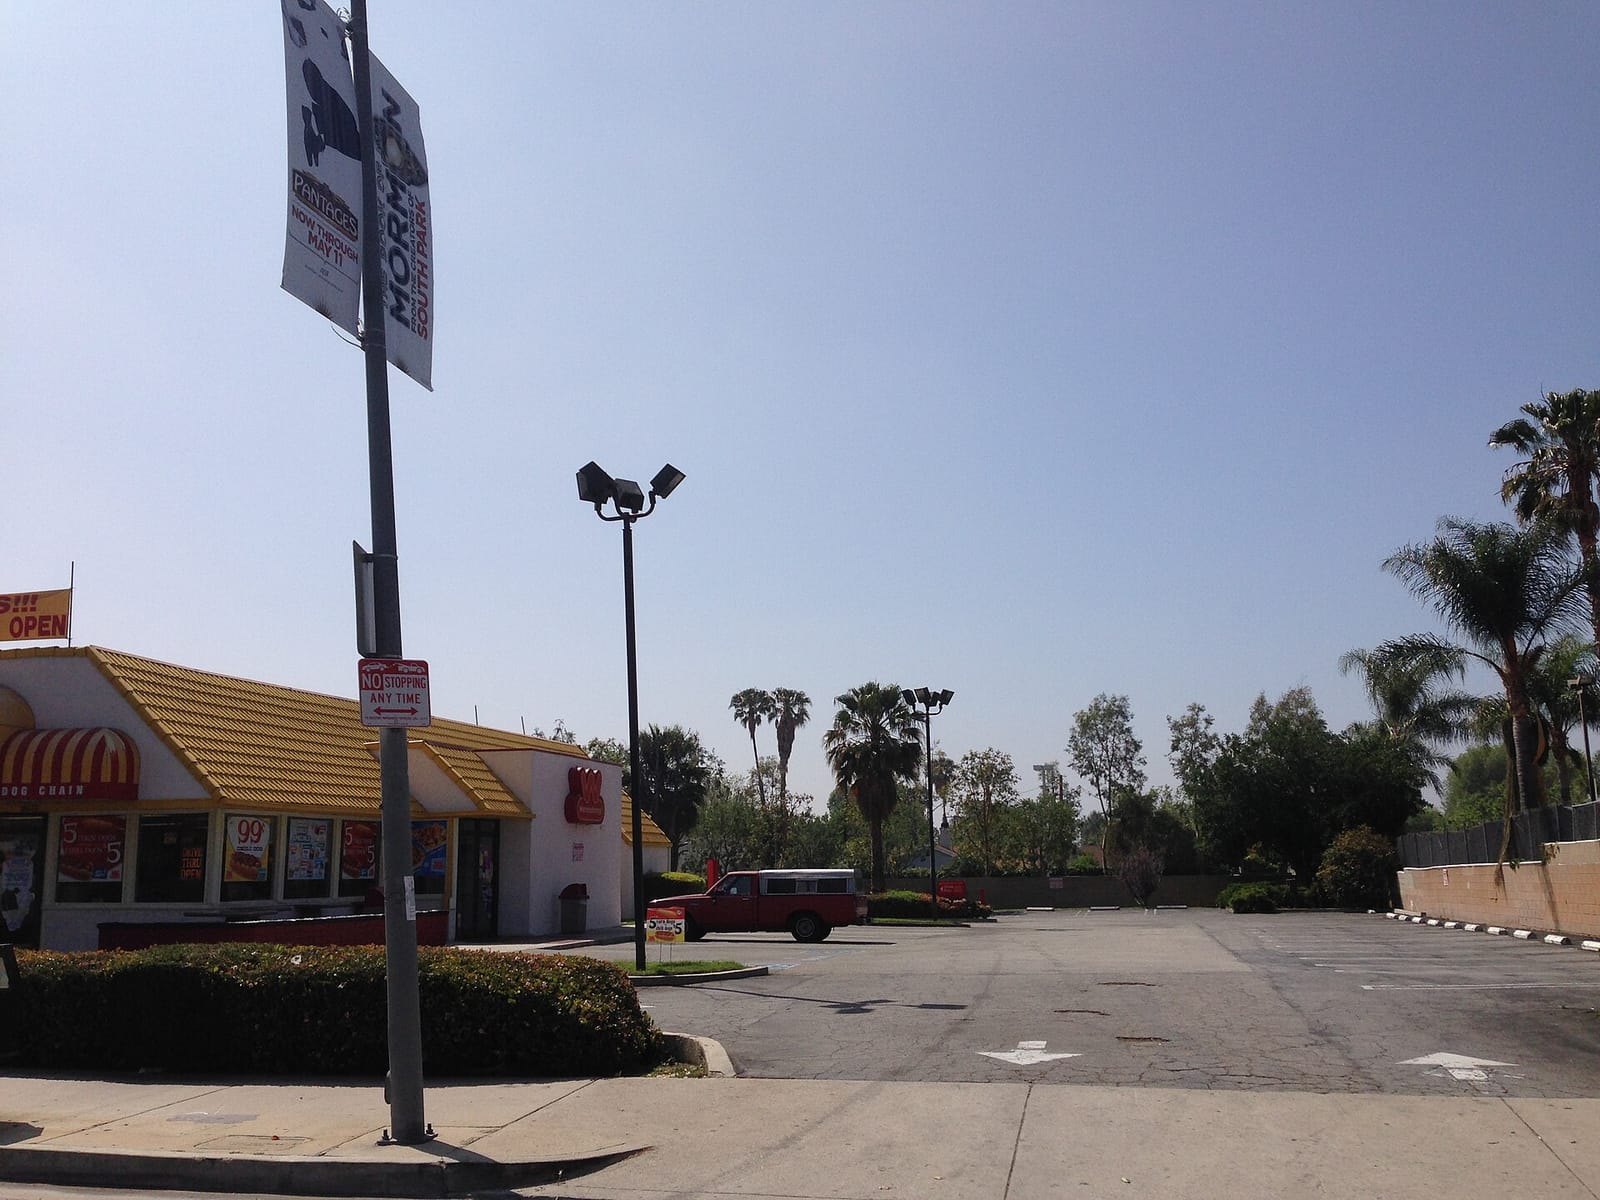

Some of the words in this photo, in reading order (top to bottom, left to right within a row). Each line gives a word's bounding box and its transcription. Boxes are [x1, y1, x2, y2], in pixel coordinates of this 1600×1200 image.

[294, 174, 358, 236] PANTAGES
[408, 191, 415, 208] OF
[292, 204, 316, 230] NOW
[317, 223, 359, 265] THROUGH
[409, 210, 417, 272] CREATORS
[415, 200, 428, 258] PARK
[307, 230, 333, 258] MAY
[333, 249, 343, 267] 11
[417, 259, 429, 340] SOUTH
[9, 614, 67, 638] OPEN
[361, 673, 382, 689] NO
[384, 676, 427, 689] STOPPING
[369, 692, 392, 704] ANY
[396, 693, 422, 704] TIME
[1, 786, 28, 796] DOG
[38, 784, 84, 796] CHAIN
[648, 917, 657, 929] 5
